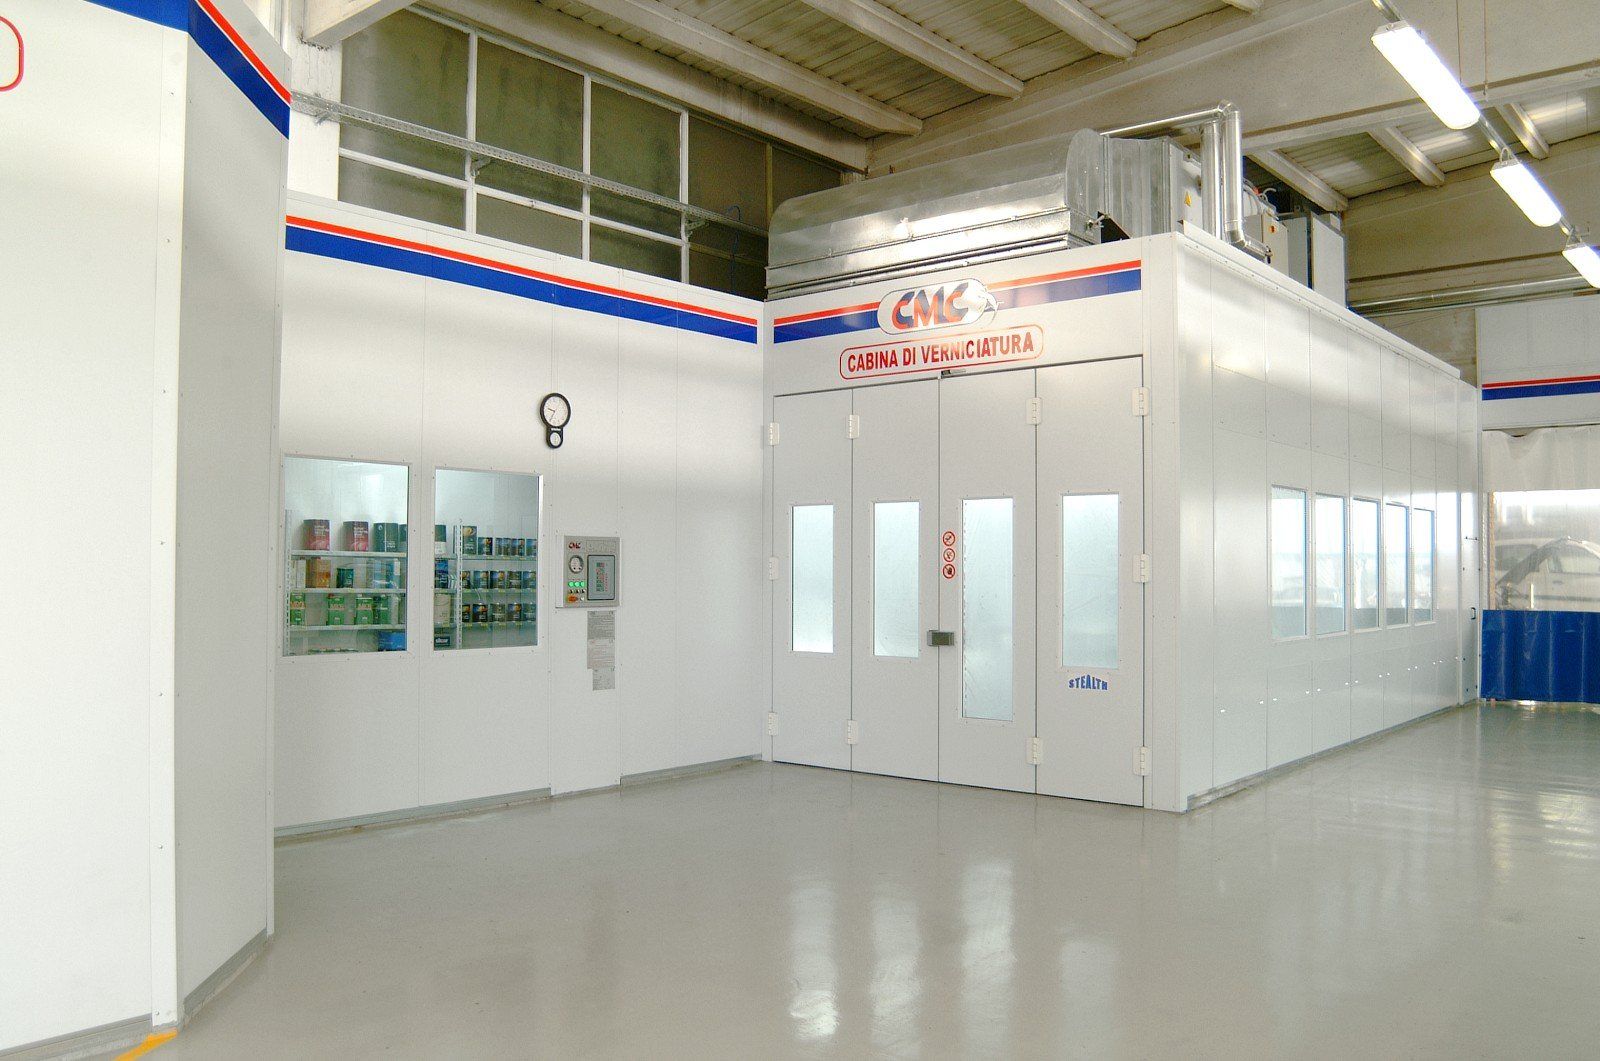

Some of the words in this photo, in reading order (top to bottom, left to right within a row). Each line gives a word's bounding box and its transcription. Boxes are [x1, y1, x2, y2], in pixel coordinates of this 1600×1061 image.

[891, 282, 969, 329] CMC
[847, 349, 899, 373] CABINA
[902, 346, 916, 366] DI
[921, 331, 1034, 364] VERNICIATURA
